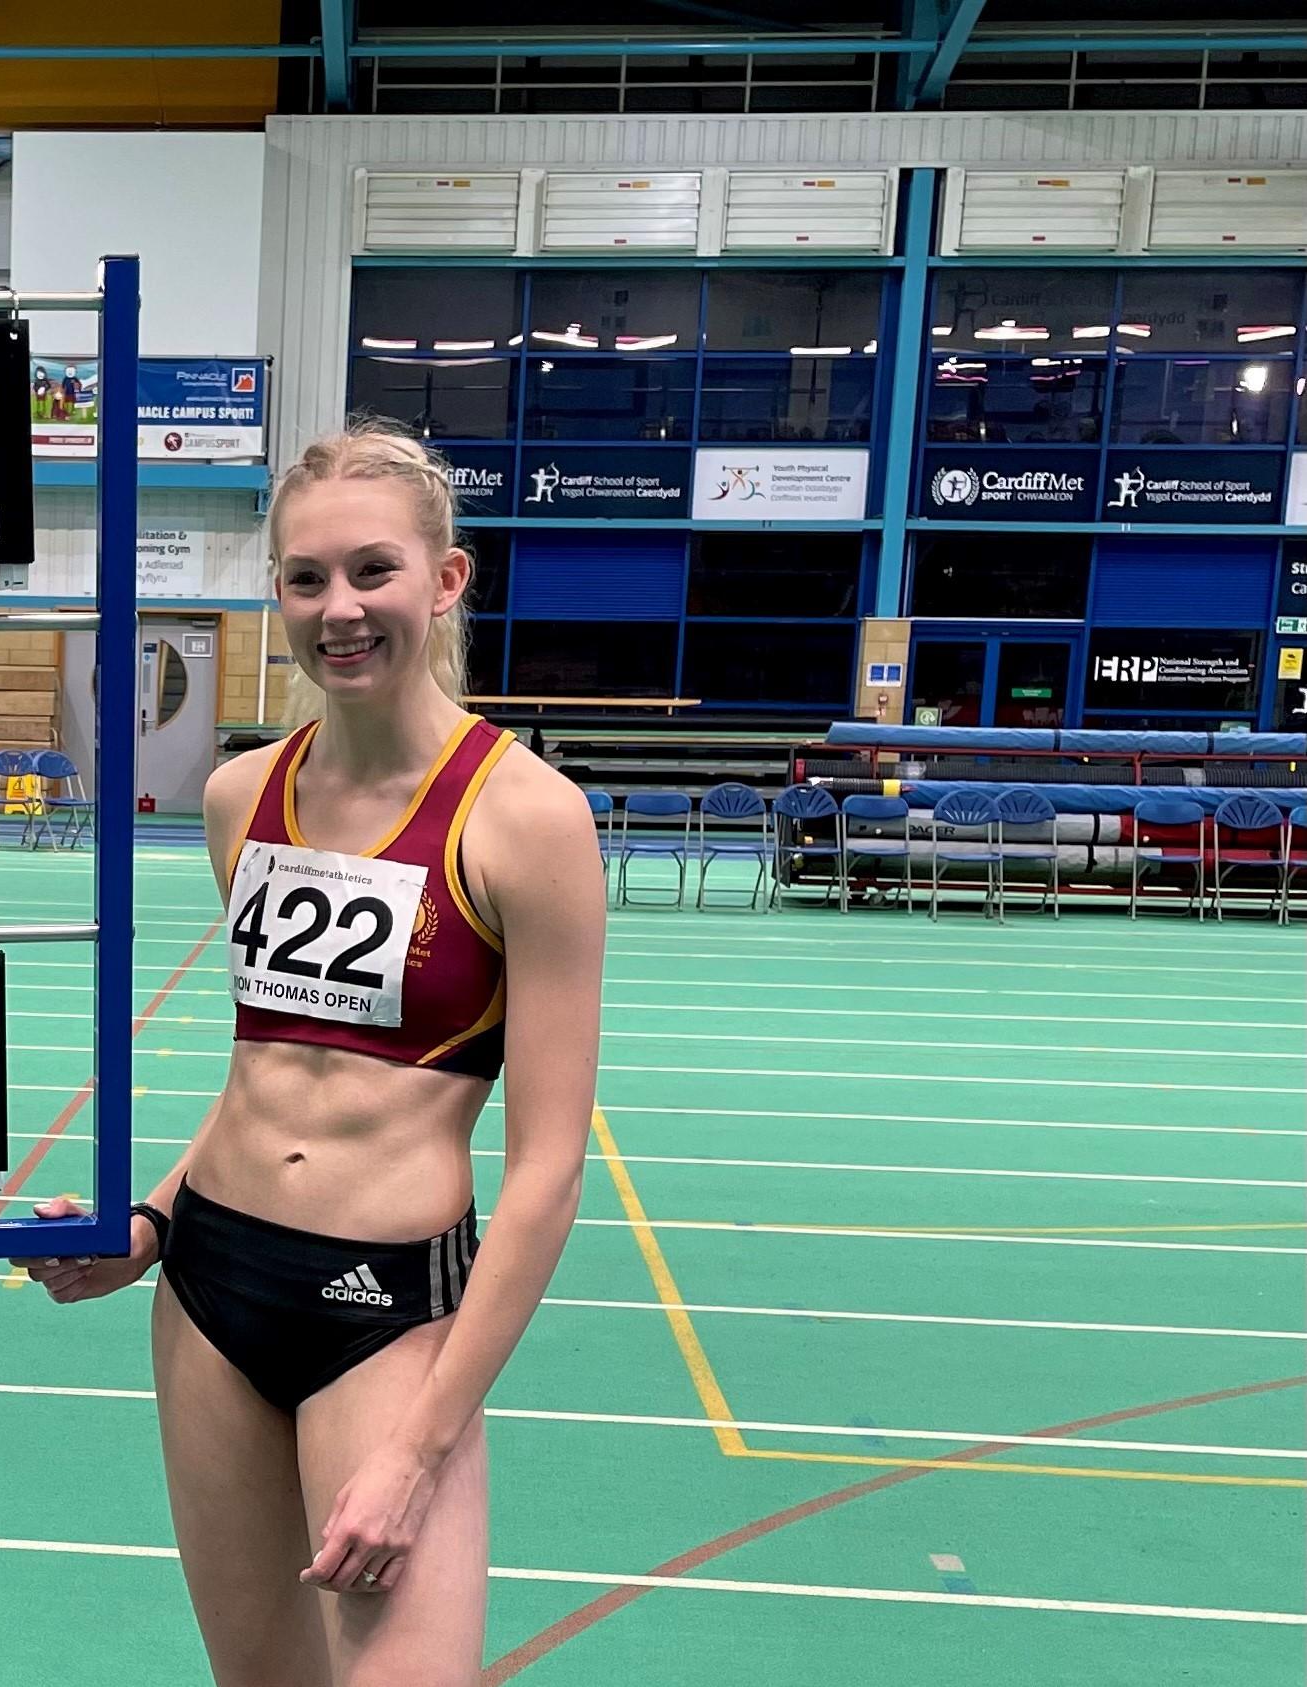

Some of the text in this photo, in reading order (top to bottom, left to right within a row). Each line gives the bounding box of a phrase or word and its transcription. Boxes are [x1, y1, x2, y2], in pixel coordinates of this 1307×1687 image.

[172, 406, 216, 420] CAMPUS
[218, 407, 255, 420] SPORT!
[797, 465, 829, 473] Physical
[561, 475, 660, 488] Cardiff School of Sport
[1146, 480, 1250, 492] Cardiff School of Sport
[561, 487, 585, 498] Ysgol
[636, 487, 681, 500] Caerdydd
[981, 491, 1073, 501] SPORT CHWARAEON
[1145, 492, 1171, 503] Ysgol
[1224, 492, 1272, 504] Caerdydd
[167, 544, 191, 555] Gym
[1159, 656, 1191, 666] National
[1094, 655, 1159, 682] ERP
[1158, 666, 1206, 676] Conditioning
[231, 881, 394, 990] 422
[408, 945, 431, 958] Met
[254, 979, 320, 1005] THOMAS
[324, 991, 372, 1013] OPEN
[321, 1283, 393, 1307] adidas
